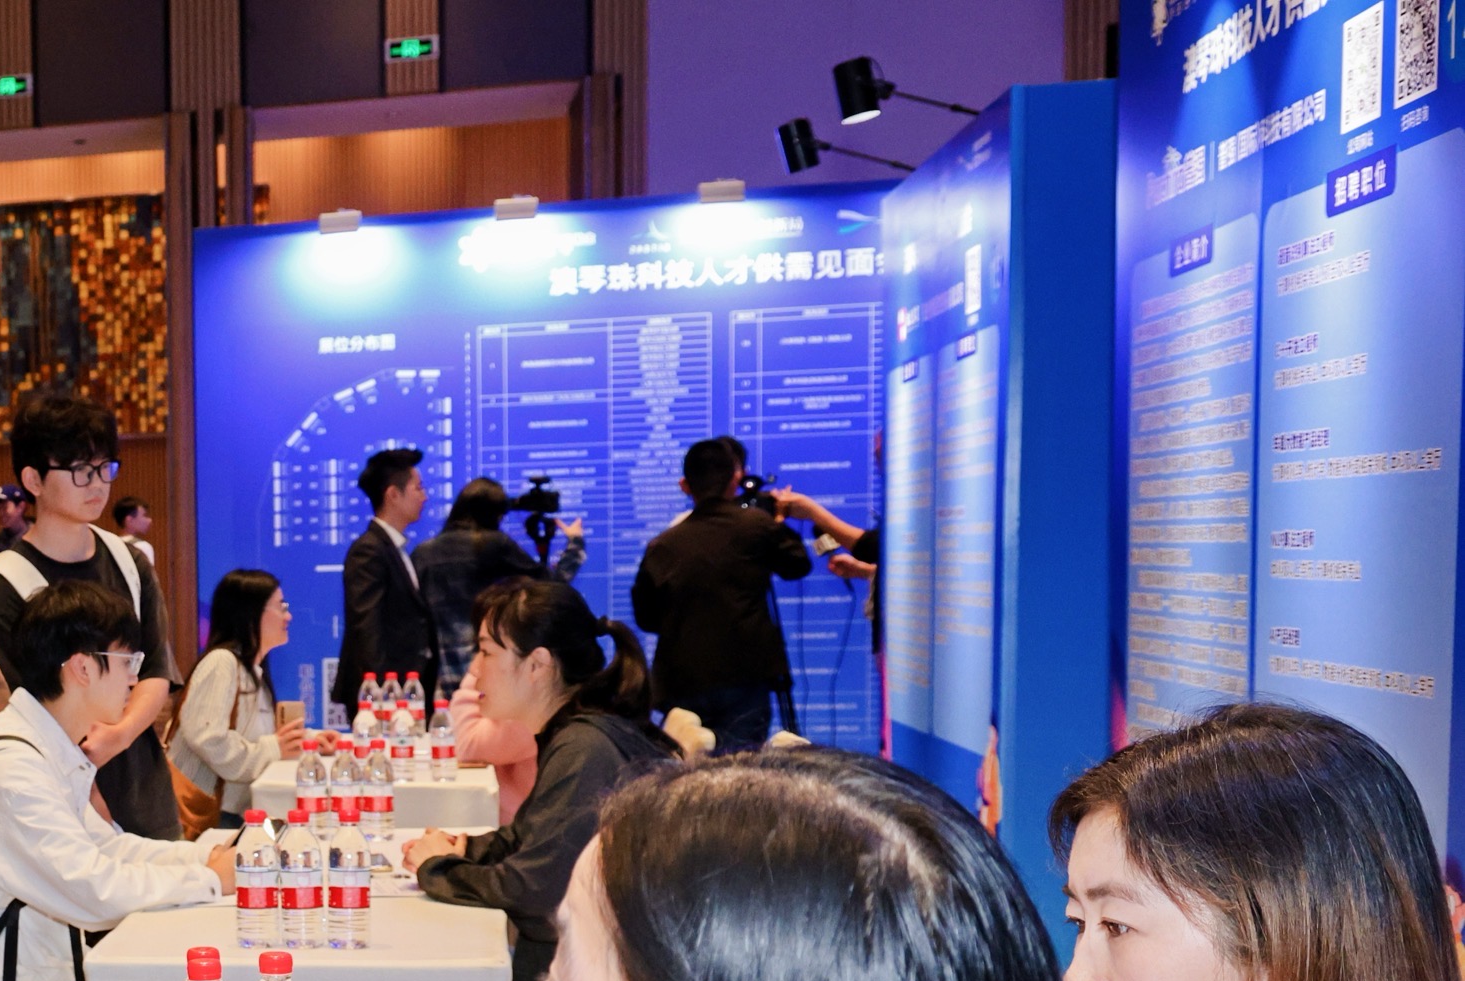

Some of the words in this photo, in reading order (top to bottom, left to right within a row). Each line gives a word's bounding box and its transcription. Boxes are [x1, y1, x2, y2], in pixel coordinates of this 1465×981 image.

[1183, 0, 1327, 93] 澳琴珠科技人才供
[1334, 159, 1386, 208] 招聘职位
